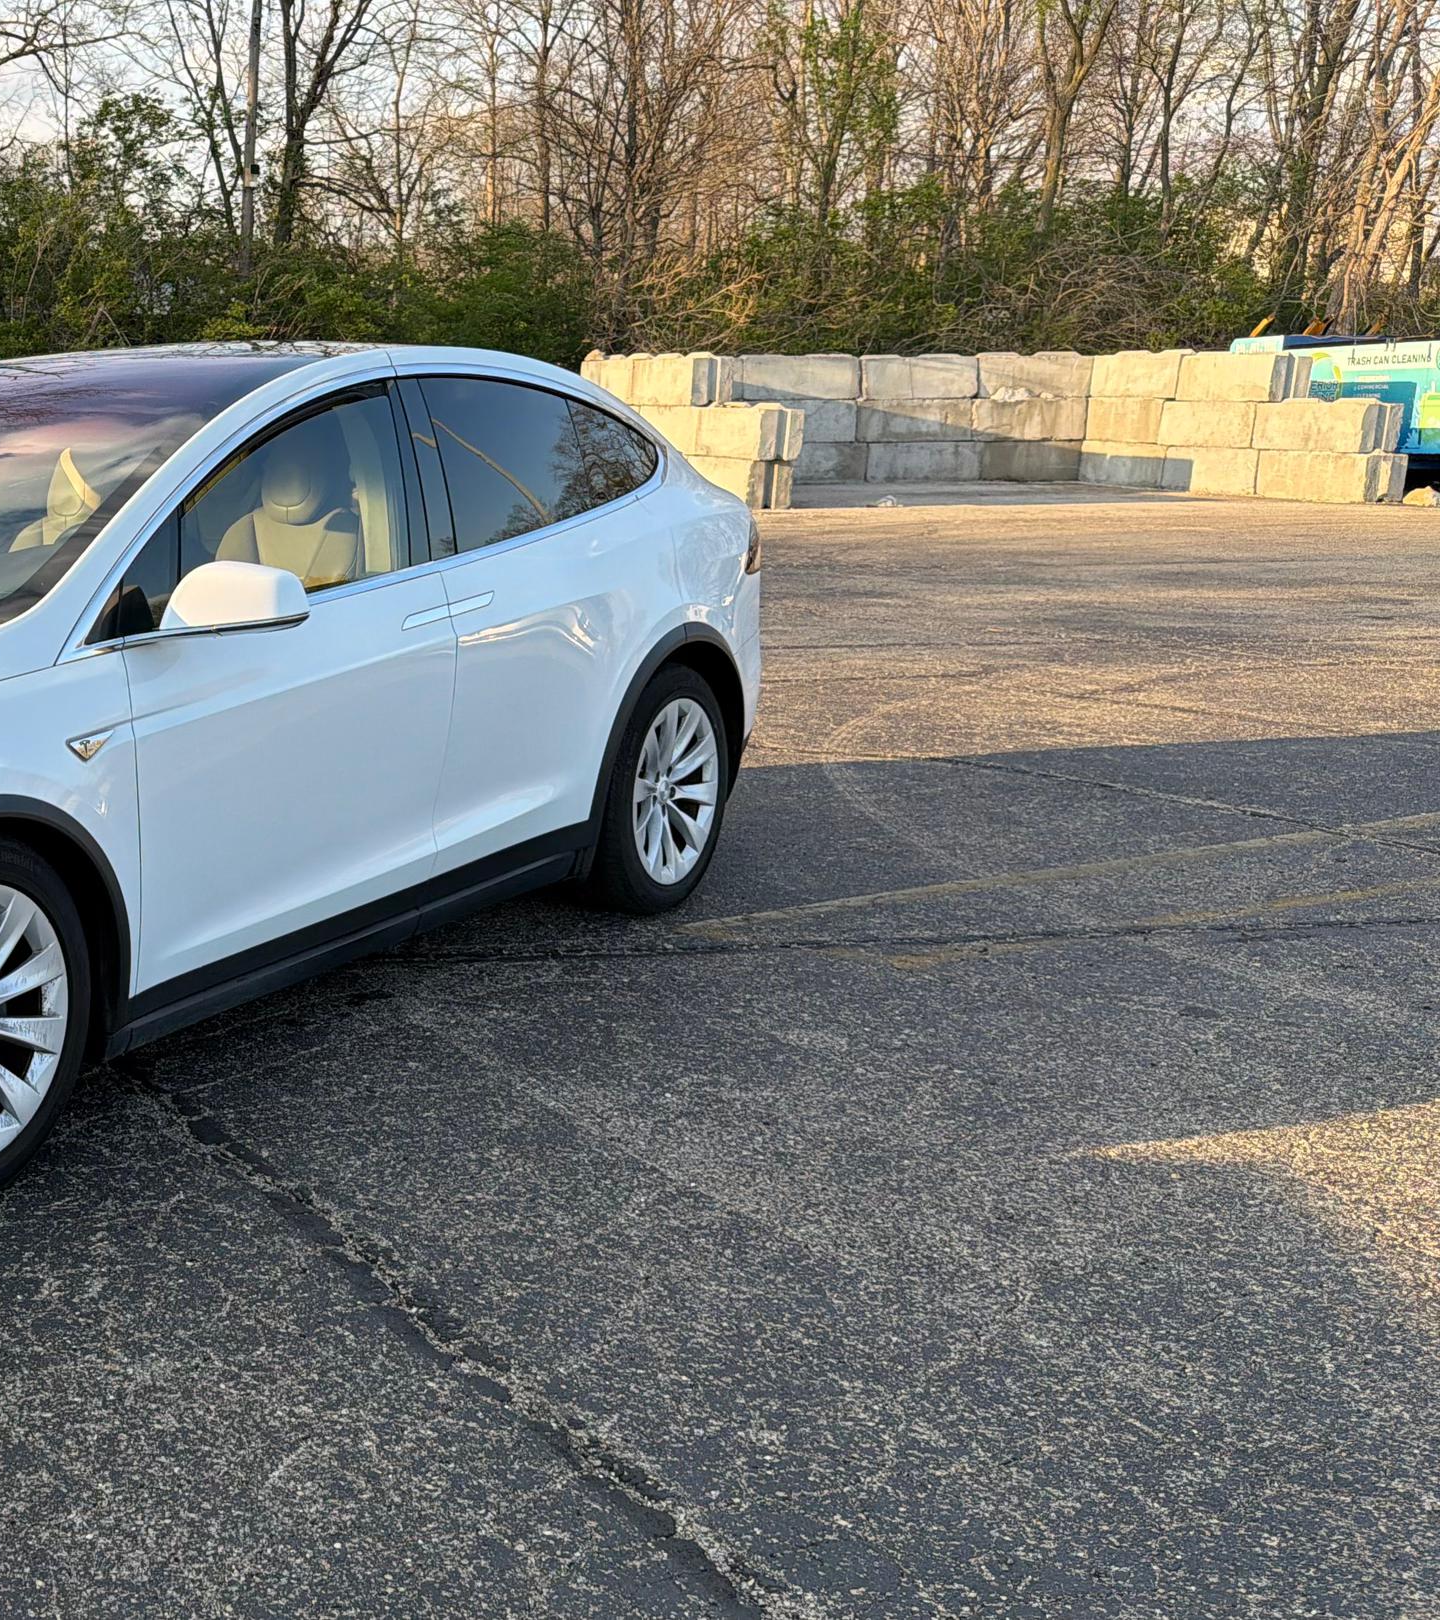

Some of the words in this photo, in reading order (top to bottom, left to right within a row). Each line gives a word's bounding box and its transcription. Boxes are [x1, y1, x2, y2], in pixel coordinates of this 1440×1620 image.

[1347, 356, 1372, 366] TRASH
[1373, 355, 1390, 365] CAN
[1391, 353, 1432, 364] CLEANING
